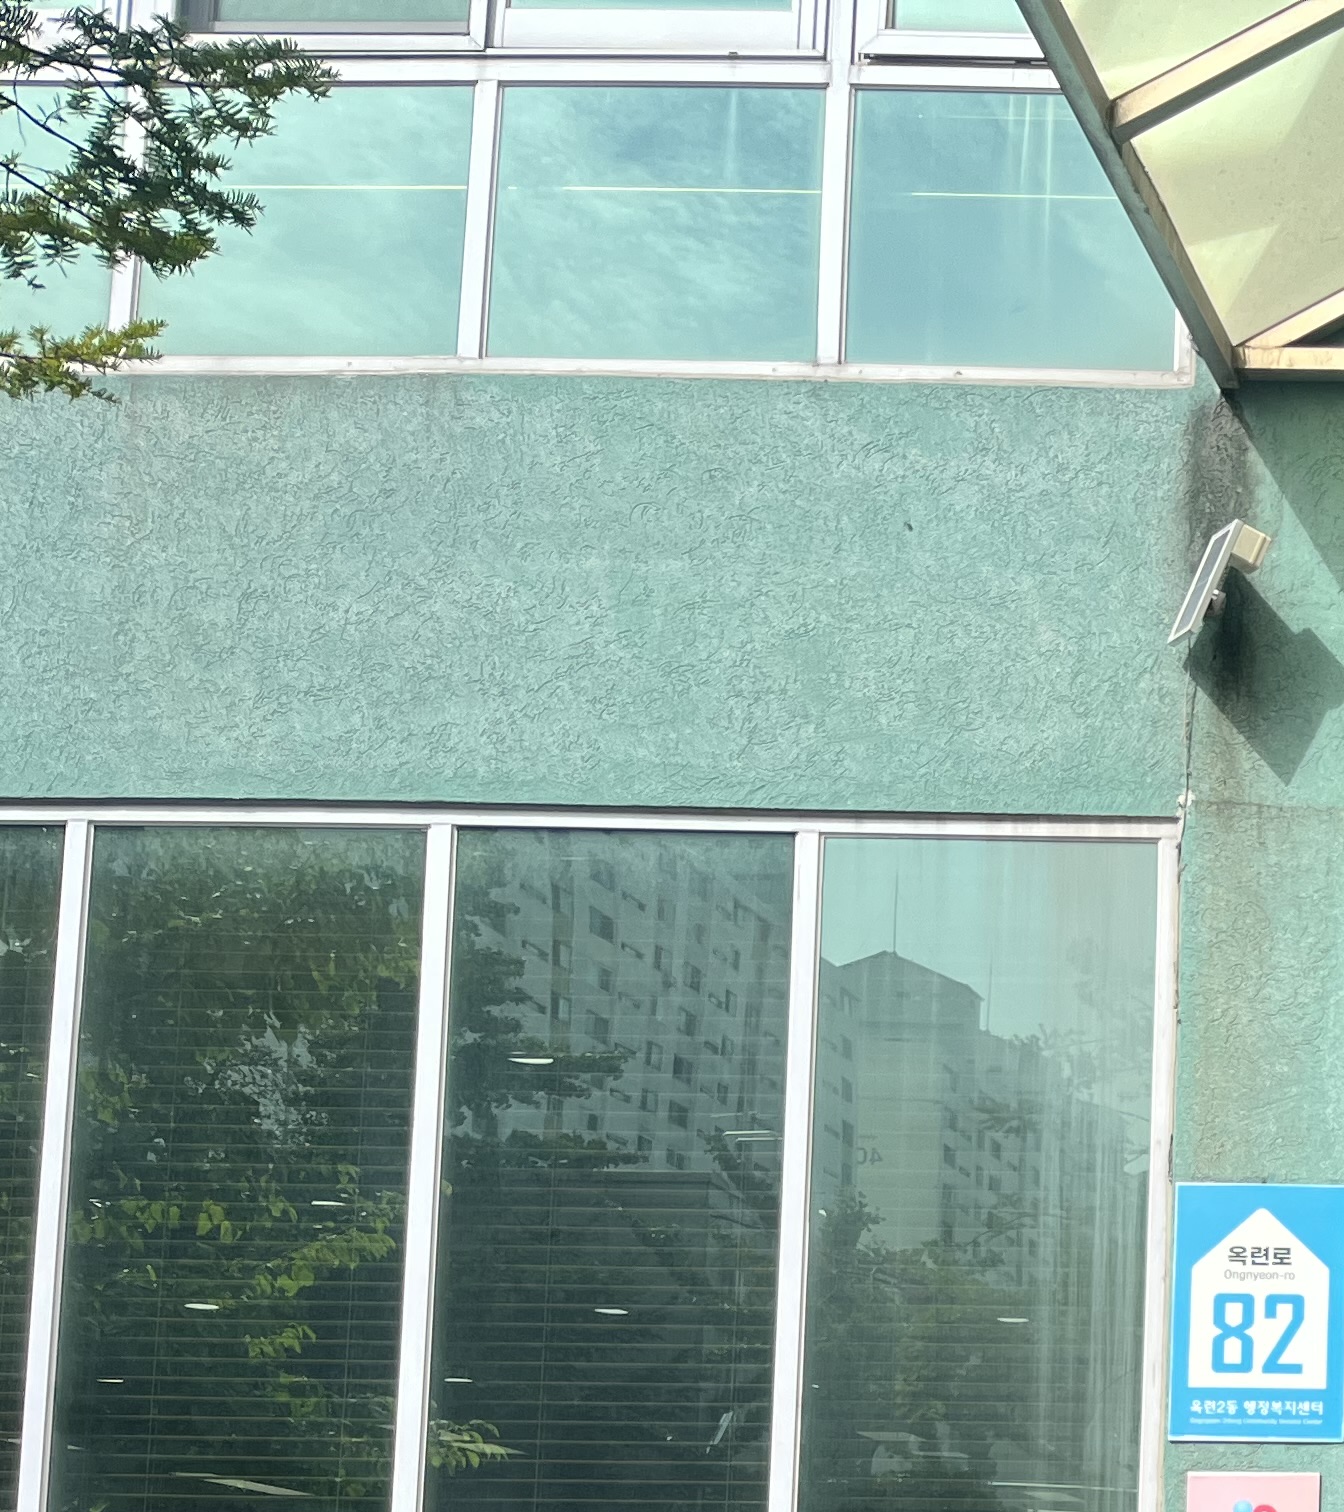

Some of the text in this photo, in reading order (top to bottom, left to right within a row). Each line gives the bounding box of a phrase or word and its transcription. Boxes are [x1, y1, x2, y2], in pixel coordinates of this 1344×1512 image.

[1228, 1246, 1292, 1266] 옥련로
[1224, 1269, 1295, 1281] Ongnyeon-ro
[1212, 1293, 1305, 1374] 82
[1190, 1399, 1324, 1416] 옥련2동 행정복지센터
